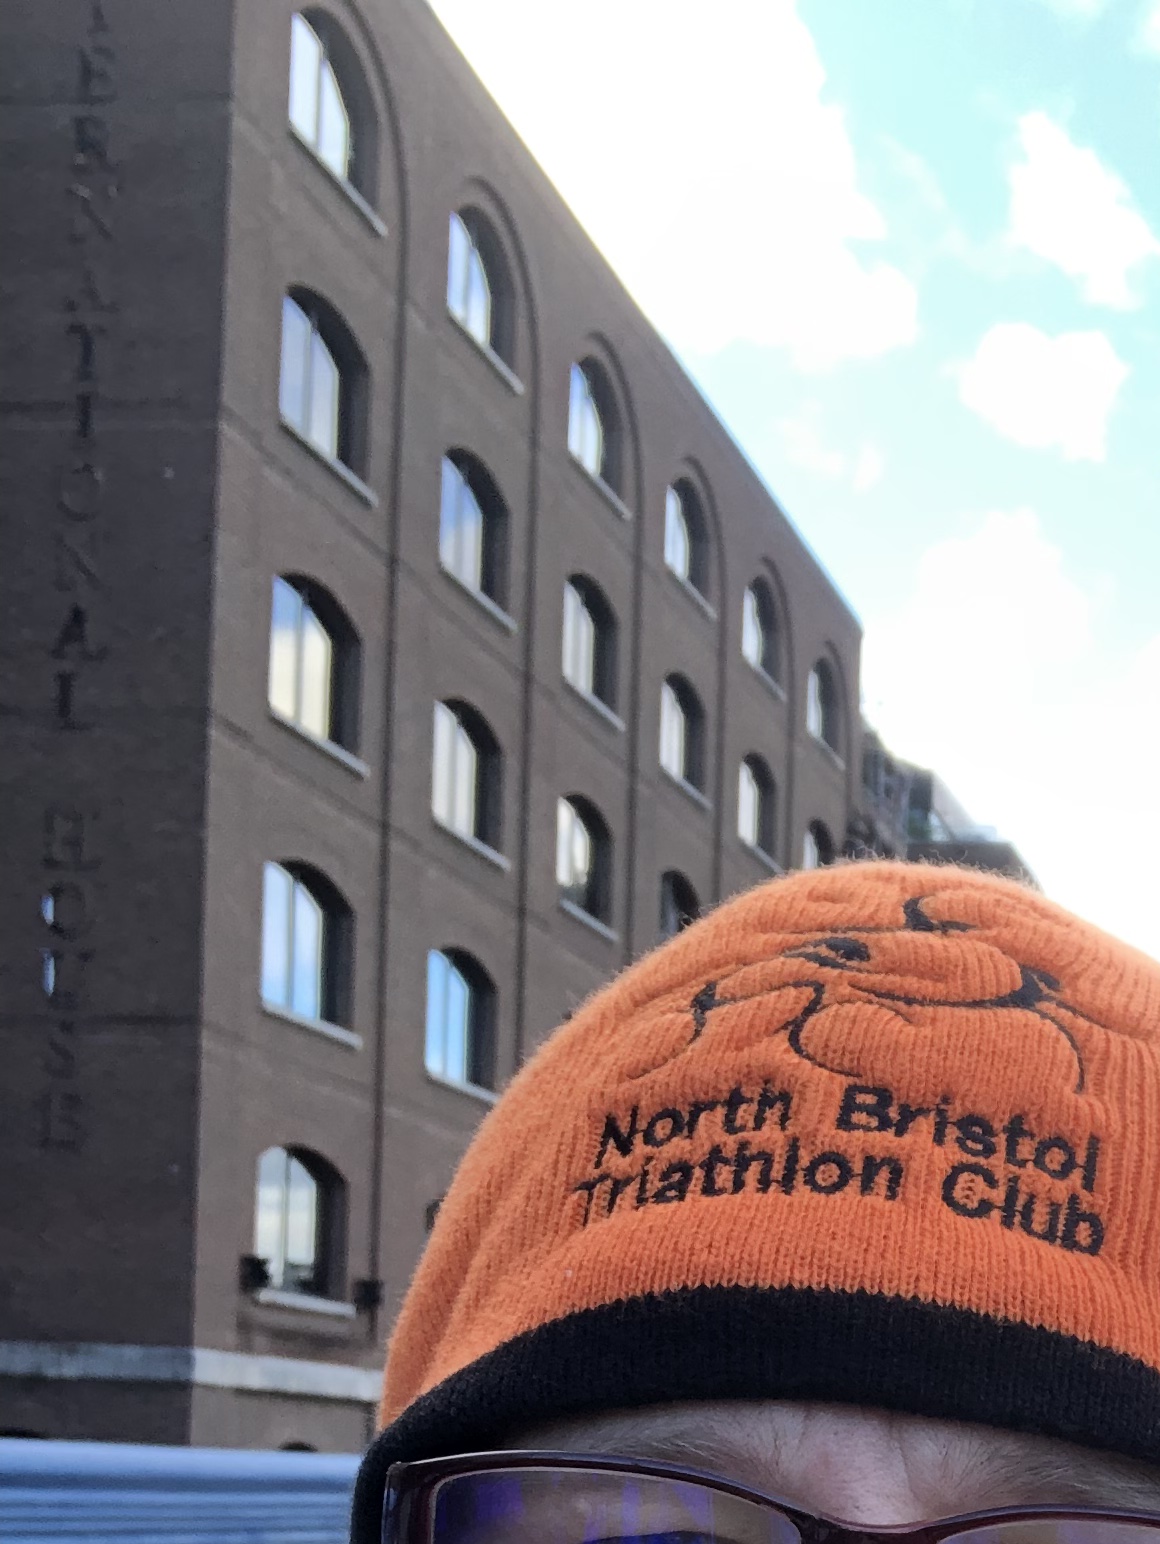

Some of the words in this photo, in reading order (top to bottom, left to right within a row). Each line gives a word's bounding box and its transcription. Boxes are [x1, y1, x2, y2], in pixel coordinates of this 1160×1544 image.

[594, 1080, 792, 1168] North
[835, 1084, 1099, 1191] Bristol
[574, 1137, 902, 1227] Triathlon
[942, 1162, 1105, 1255] Club
